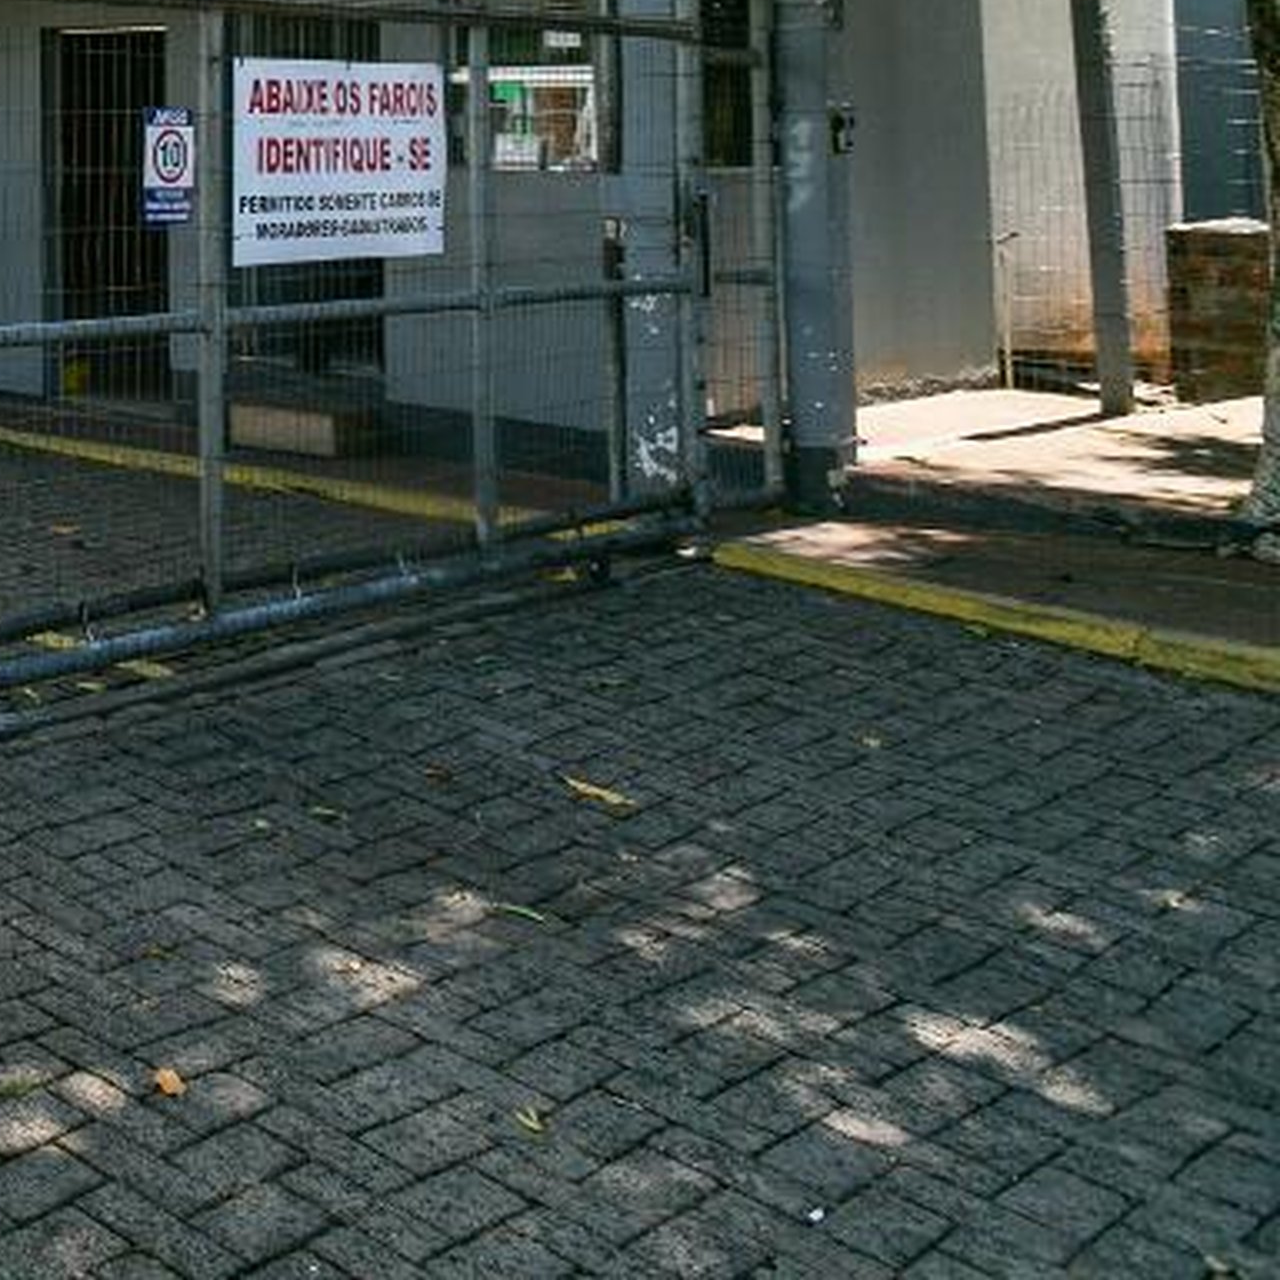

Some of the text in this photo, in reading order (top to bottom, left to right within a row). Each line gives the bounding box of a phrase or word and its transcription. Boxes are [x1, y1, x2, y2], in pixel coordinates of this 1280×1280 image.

[248, 79, 328, 114] ABAIXE
[334, 80, 361, 116] OS
[160, 140, 180, 168] 10
[258, 137, 391, 174] IDENTIFIQUE
[409, 137, 431, 171] SE
[240, 194, 315, 214] PERMITIDO
[319, 193, 377, 211] SOMENTE
